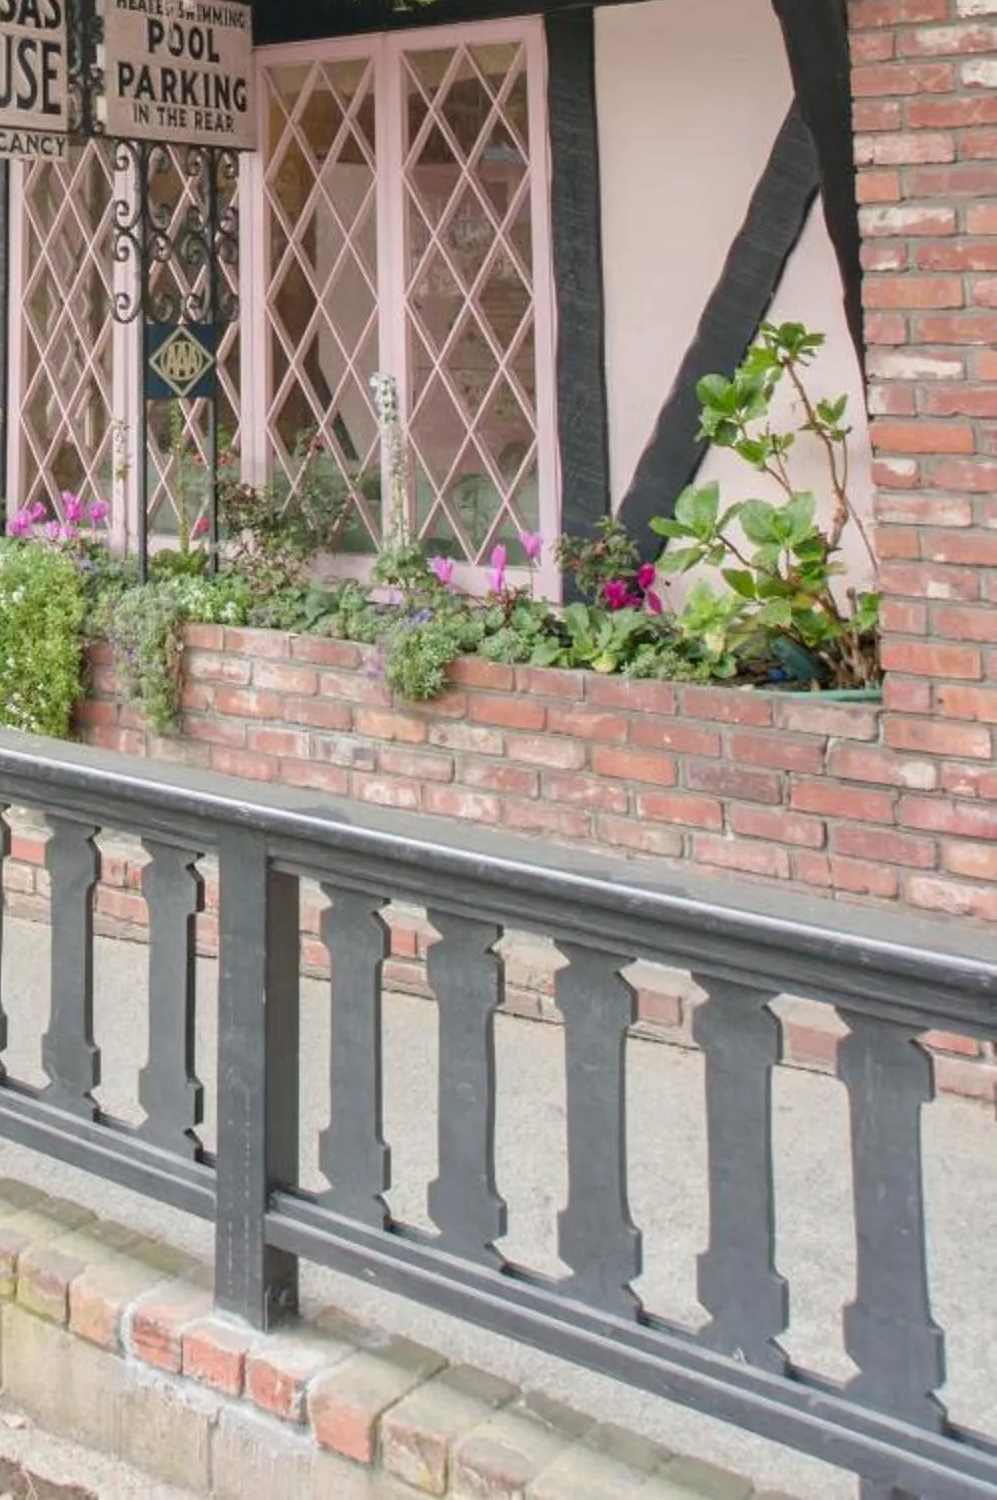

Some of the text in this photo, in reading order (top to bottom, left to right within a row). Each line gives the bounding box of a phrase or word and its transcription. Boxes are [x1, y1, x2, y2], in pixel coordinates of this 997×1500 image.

[147, 18, 220, 64] POOL
[117, 61, 248, 113] PARKING
[133, 104, 235, 134] IN THE REAR
